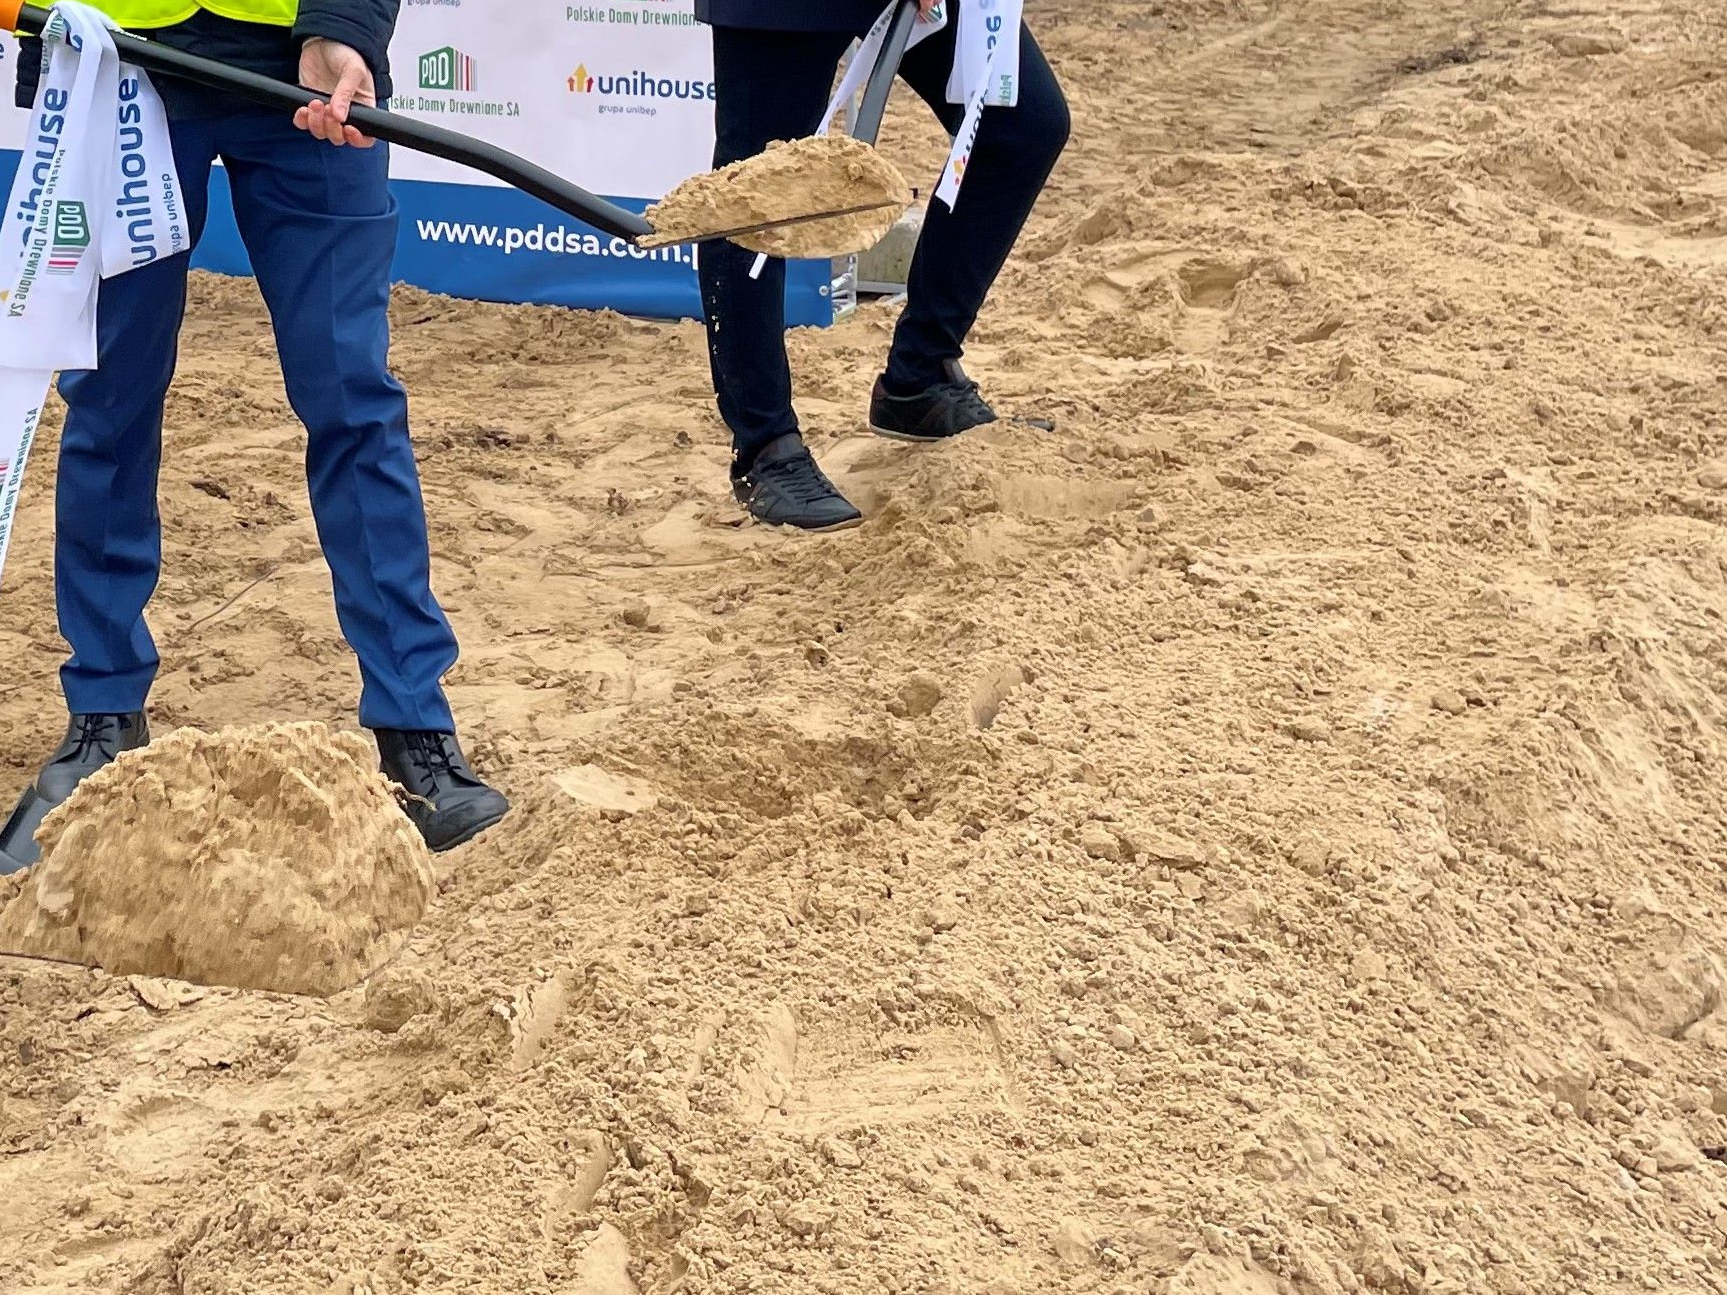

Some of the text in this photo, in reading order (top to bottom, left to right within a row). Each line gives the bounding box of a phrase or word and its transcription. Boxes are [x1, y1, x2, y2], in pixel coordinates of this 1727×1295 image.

[566, 6, 605, 23] Polskie
[609, 8, 638, 26] Domy
[421, 51, 450, 86] PDD
[598, 70, 717, 101] unihouse
[389, 94, 520, 117] lskie Domy Drewniane SA
[116, 77, 158, 266] unihouse
[8, 149, 66, 318] Polskie Domy Drewniane SA
[58, 204, 85, 240] PDD
[25, 407, 39, 424] SA
